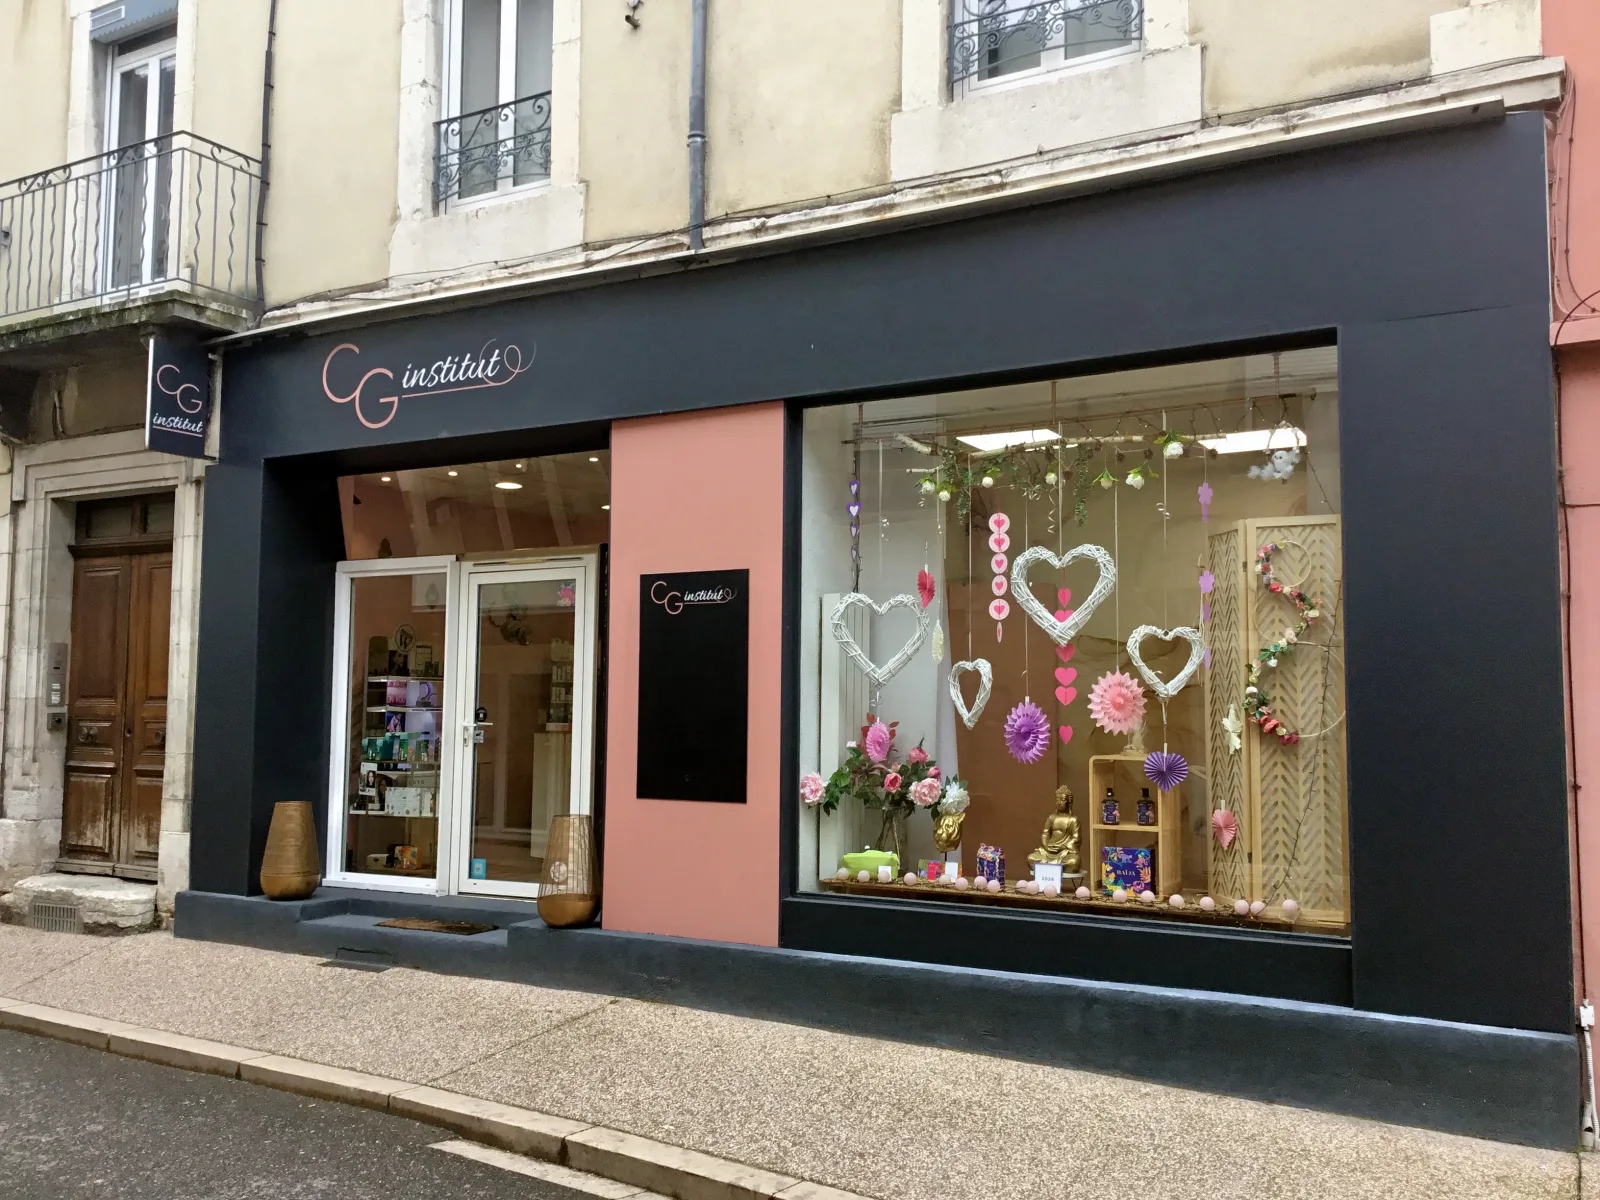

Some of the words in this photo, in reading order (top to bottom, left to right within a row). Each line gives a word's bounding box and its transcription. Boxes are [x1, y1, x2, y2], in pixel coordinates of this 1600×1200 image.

[402, 349, 501, 388] institut
[152, 412, 203, 433] institut
[684, 589, 724, 602] institut
